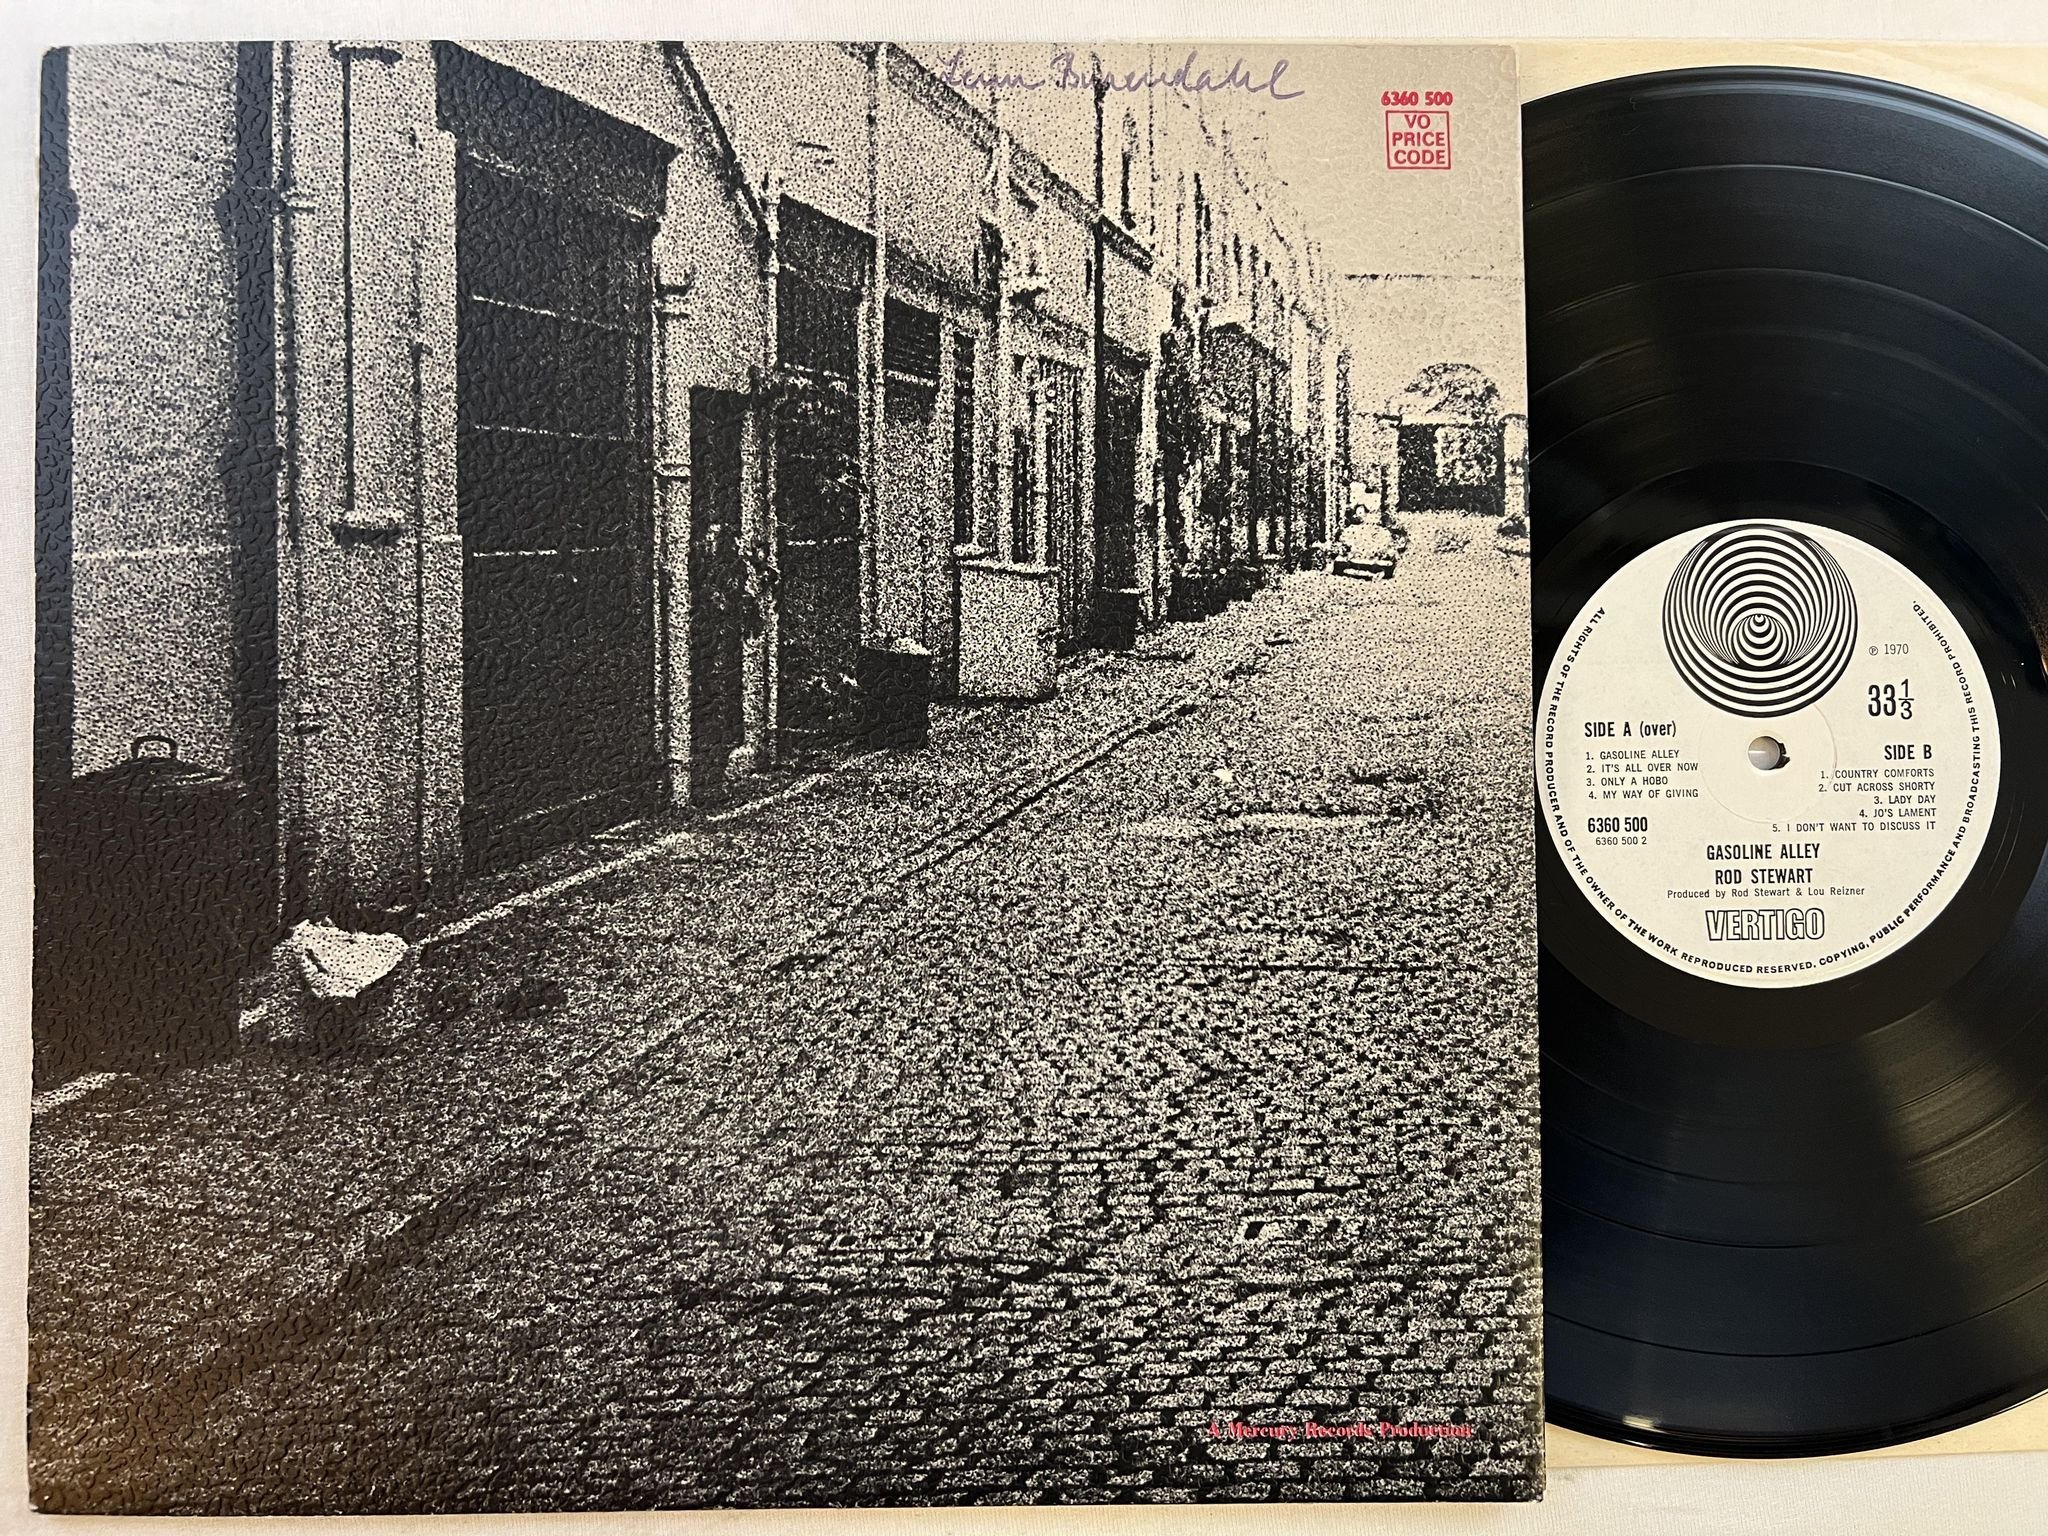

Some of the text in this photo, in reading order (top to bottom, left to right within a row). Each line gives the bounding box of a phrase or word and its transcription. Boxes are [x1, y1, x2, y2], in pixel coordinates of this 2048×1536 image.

[1382, 91, 1453, 106] 6360 500
[1404, 114, 1431, 129] VO
[1393, 131, 1445, 148] PRICE
[1394, 149, 1446, 165] CODE
[1885, 644, 1908, 654] 1970
[1585, 721, 1676, 738] SIDE A (over)
[1586, 750, 1679, 760] 1. GASOLINE ALLEY
[1884, 744, 1932, 760] SIDE B
[1587, 763, 1698, 773] 2. IT'S ALL OVER NOW
[1821, 769, 1934, 779] 1. COUNTRY COMFORTS
[1545, 601, 1980, 973] ALL RIGHTS OF THE RECORD PRODUCER AND OF THE OWNER OF THE WORK REPRODUCED RESERVED. COPYING, PUBLIC PERFORMANCE AND BROADCASTING THIS RECORD PROHIBITED.
[1586, 776, 1668, 786] 3. ONLY A HOBO
[1819, 782, 1935, 792] 2. CUT ACROSS SHORTY
[1589, 789, 1698, 799] 4. MY WAY OF GIVING
[1874, 795, 1935, 804] 3. LADY DAY
[1859, 808, 1936, 817] 4. JO'S LAMENT
[1588, 817, 1647, 833] 6360 500
[1773, 824, 1780, 832] 5.
[1797, 823, 1824, 832] DON'T
[1830, 823, 1856, 831] WANT
[1862, 822, 1874, 831] TO
[1880, 822, 1920, 830] DISCUSS
[1927, 821, 1935, 829] IT
[1596, 836, 1647, 845] 6360 500 2
[1707, 843, 1820, 860] GASOLINE ALLEY
[1715, 868, 1813, 885] ROD STEWART
[1668, 886, 1864, 899] Produced by Rod Stewart & Lou Reizner
[1705, 908, 1825, 941] VERTIGO
[1206, 1422, 1472, 1441] A Mercury Records Production
